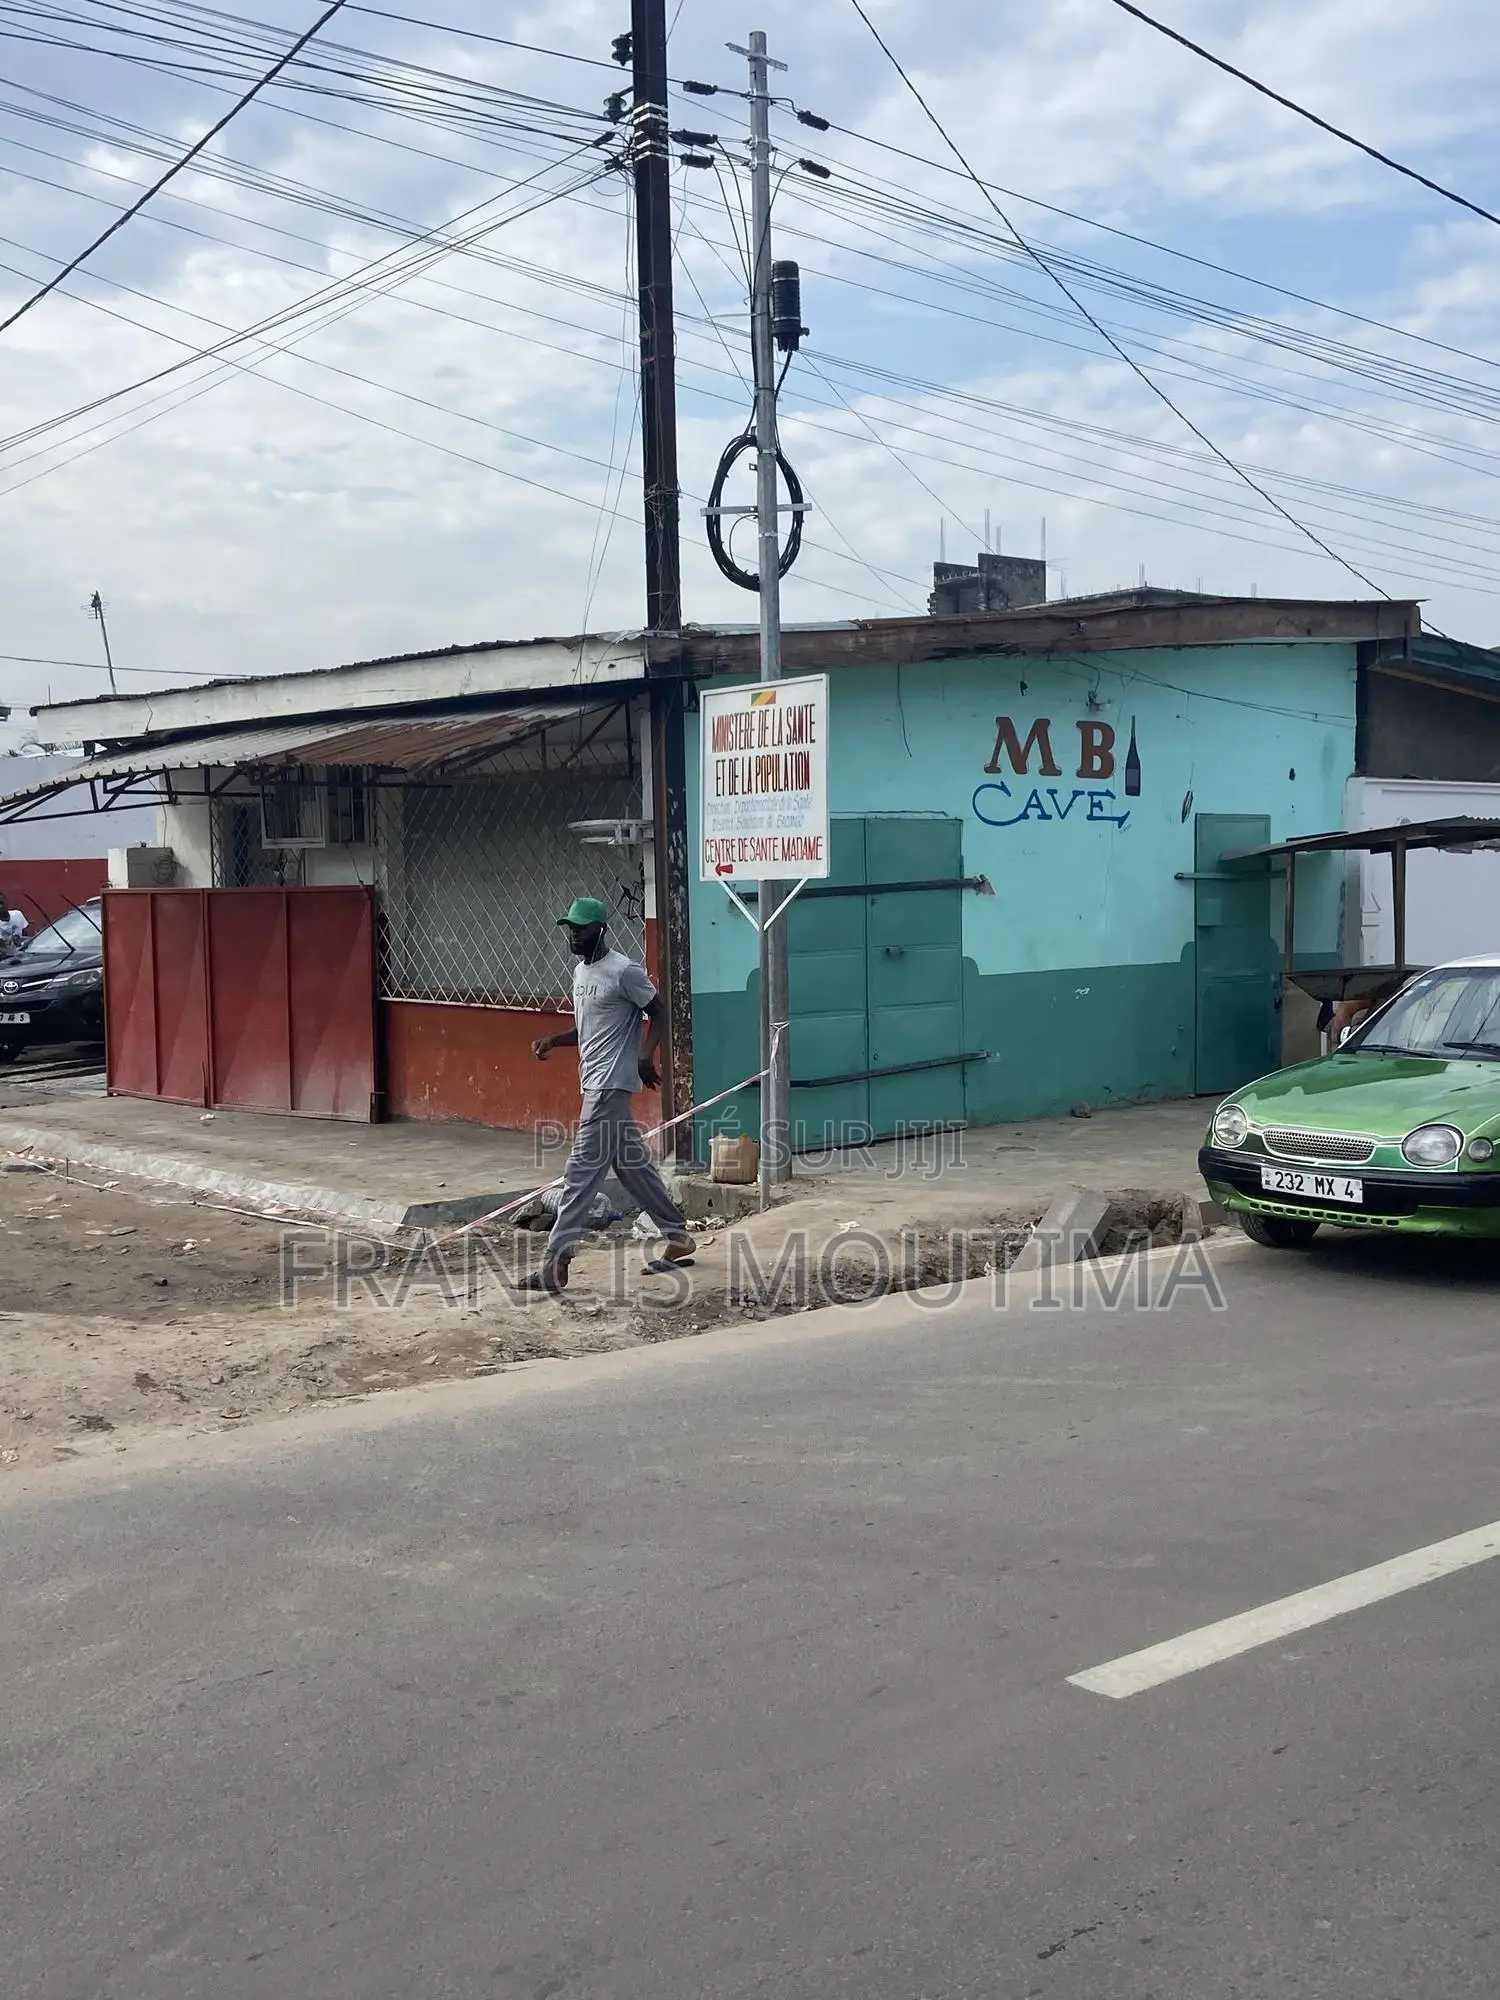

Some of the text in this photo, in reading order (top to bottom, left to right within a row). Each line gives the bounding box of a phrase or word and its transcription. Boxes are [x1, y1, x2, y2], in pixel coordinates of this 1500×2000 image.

[712, 703, 816, 753] MINISTERE DE LA SANTE
[716, 751, 810, 797] ET DE LA POPULATION
[971, 780, 1131, 829] CAVE
[704, 836, 823, 864] CENTRE DE SANTE MADAME
[1275, 1171, 1354, 1199] 232 MX 4
